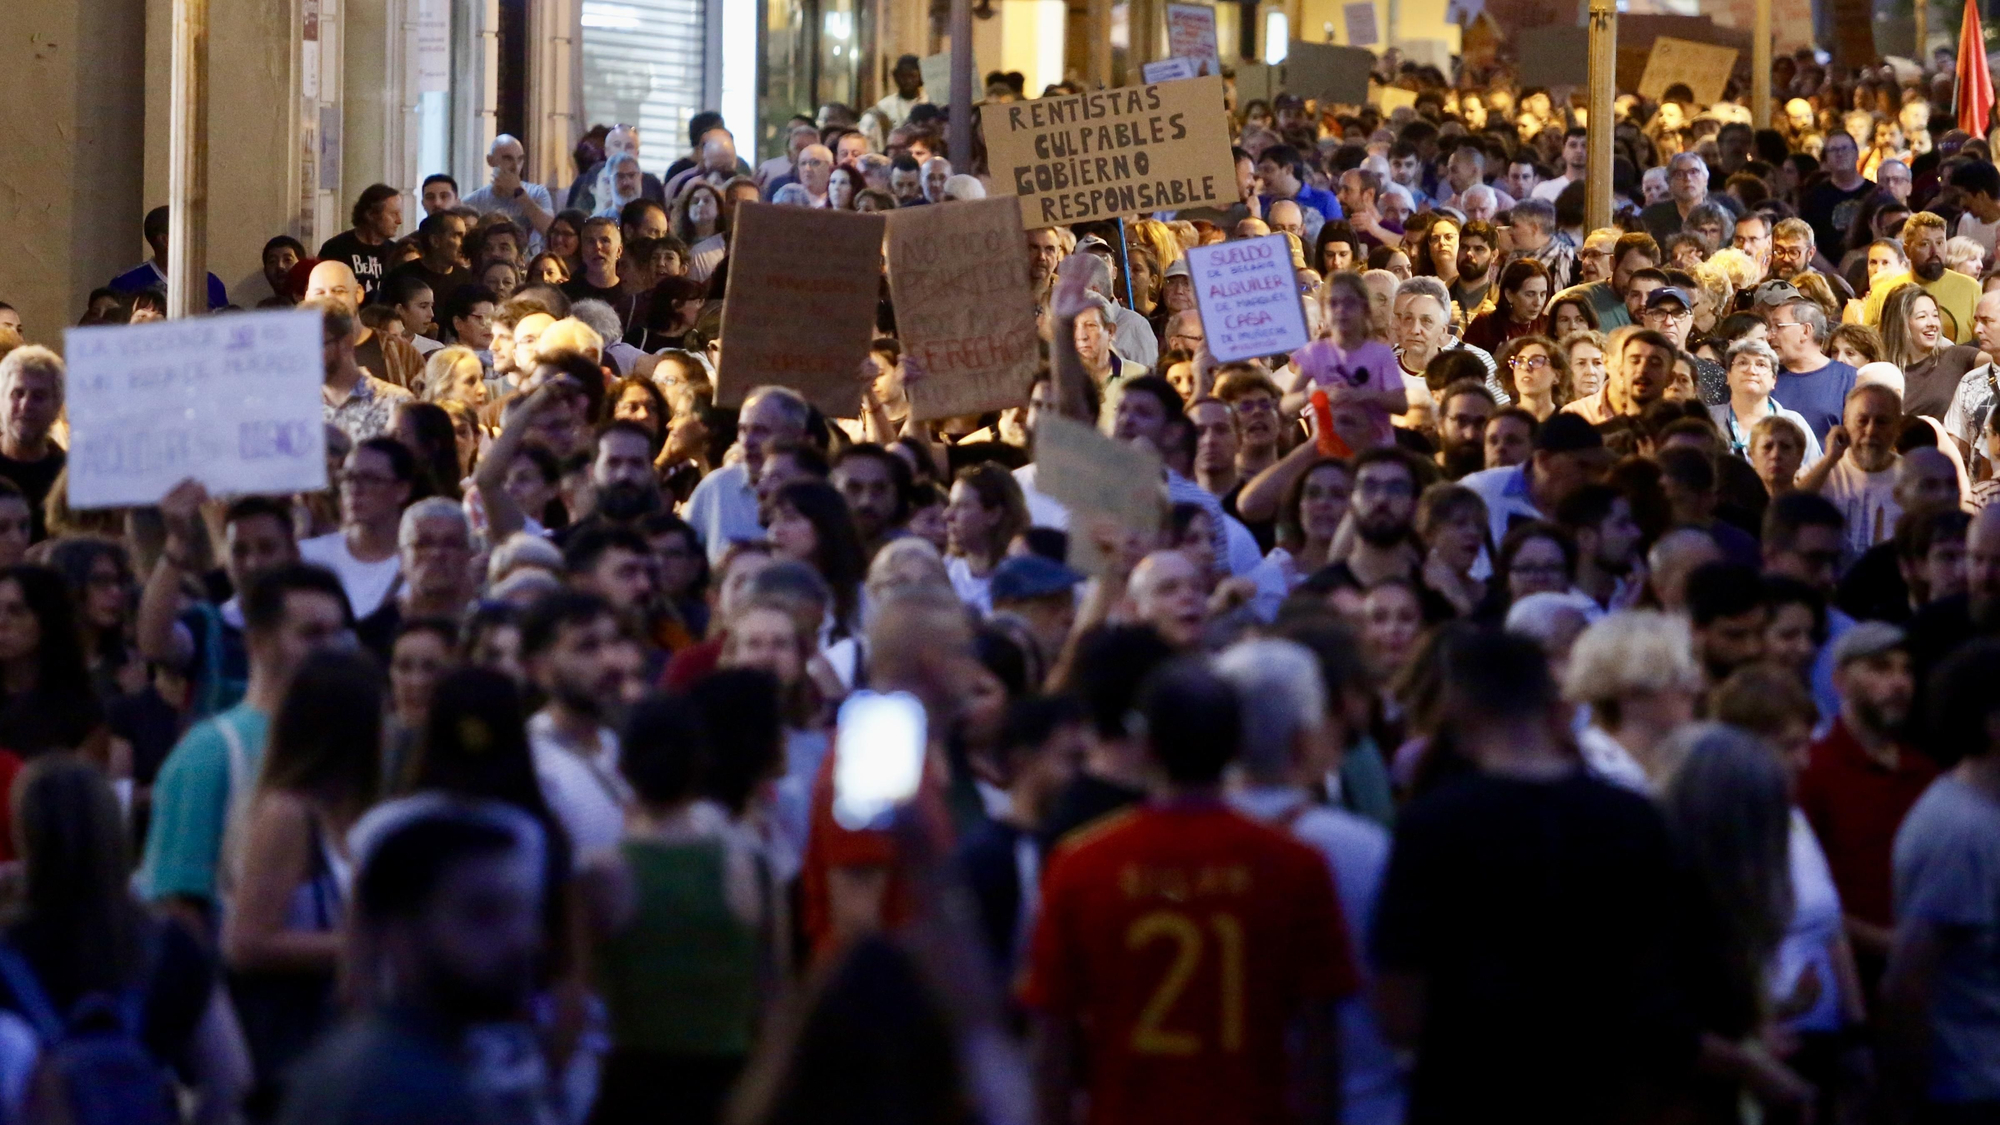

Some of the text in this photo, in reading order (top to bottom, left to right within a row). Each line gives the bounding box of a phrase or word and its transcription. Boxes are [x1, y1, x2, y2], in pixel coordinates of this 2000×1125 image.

[1009, 85, 1161, 131] RENTISTAS
[1035, 113, 1187, 160] CULPABLES
[1014, 151, 1150, 196] GOBIERNO
[1040, 176, 1217, 222] RESPONSABLE
[1210, 243, 1272, 266] SUELDO
[1209, 274, 1288, 298] ALQUILER
[1215, 302, 1232, 313] DE
[1224, 310, 1273, 330] CASA
[1125, 911, 1246, 1055] 21
